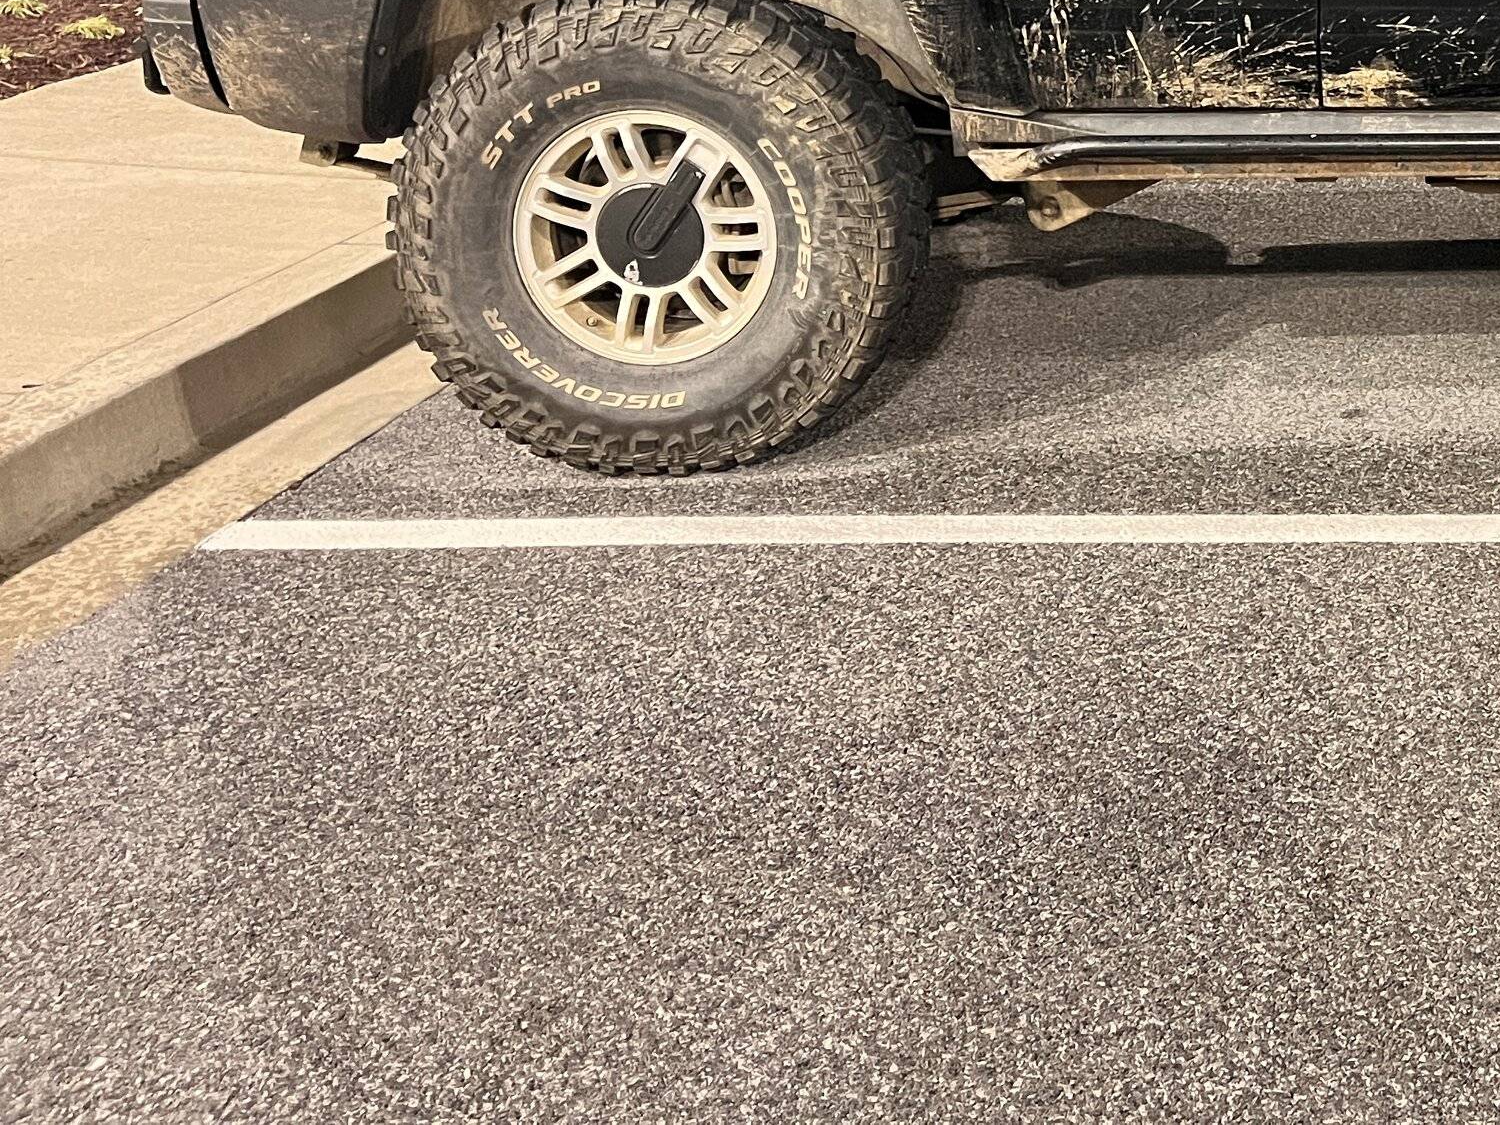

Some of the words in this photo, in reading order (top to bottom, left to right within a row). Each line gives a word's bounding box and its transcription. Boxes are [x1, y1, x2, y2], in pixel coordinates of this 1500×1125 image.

[480, 100, 535, 171] STT
[545, 79, 601, 109] PRO
[757, 137, 813, 300] COOPER
[482, 306, 687, 411] DISCOVERER
